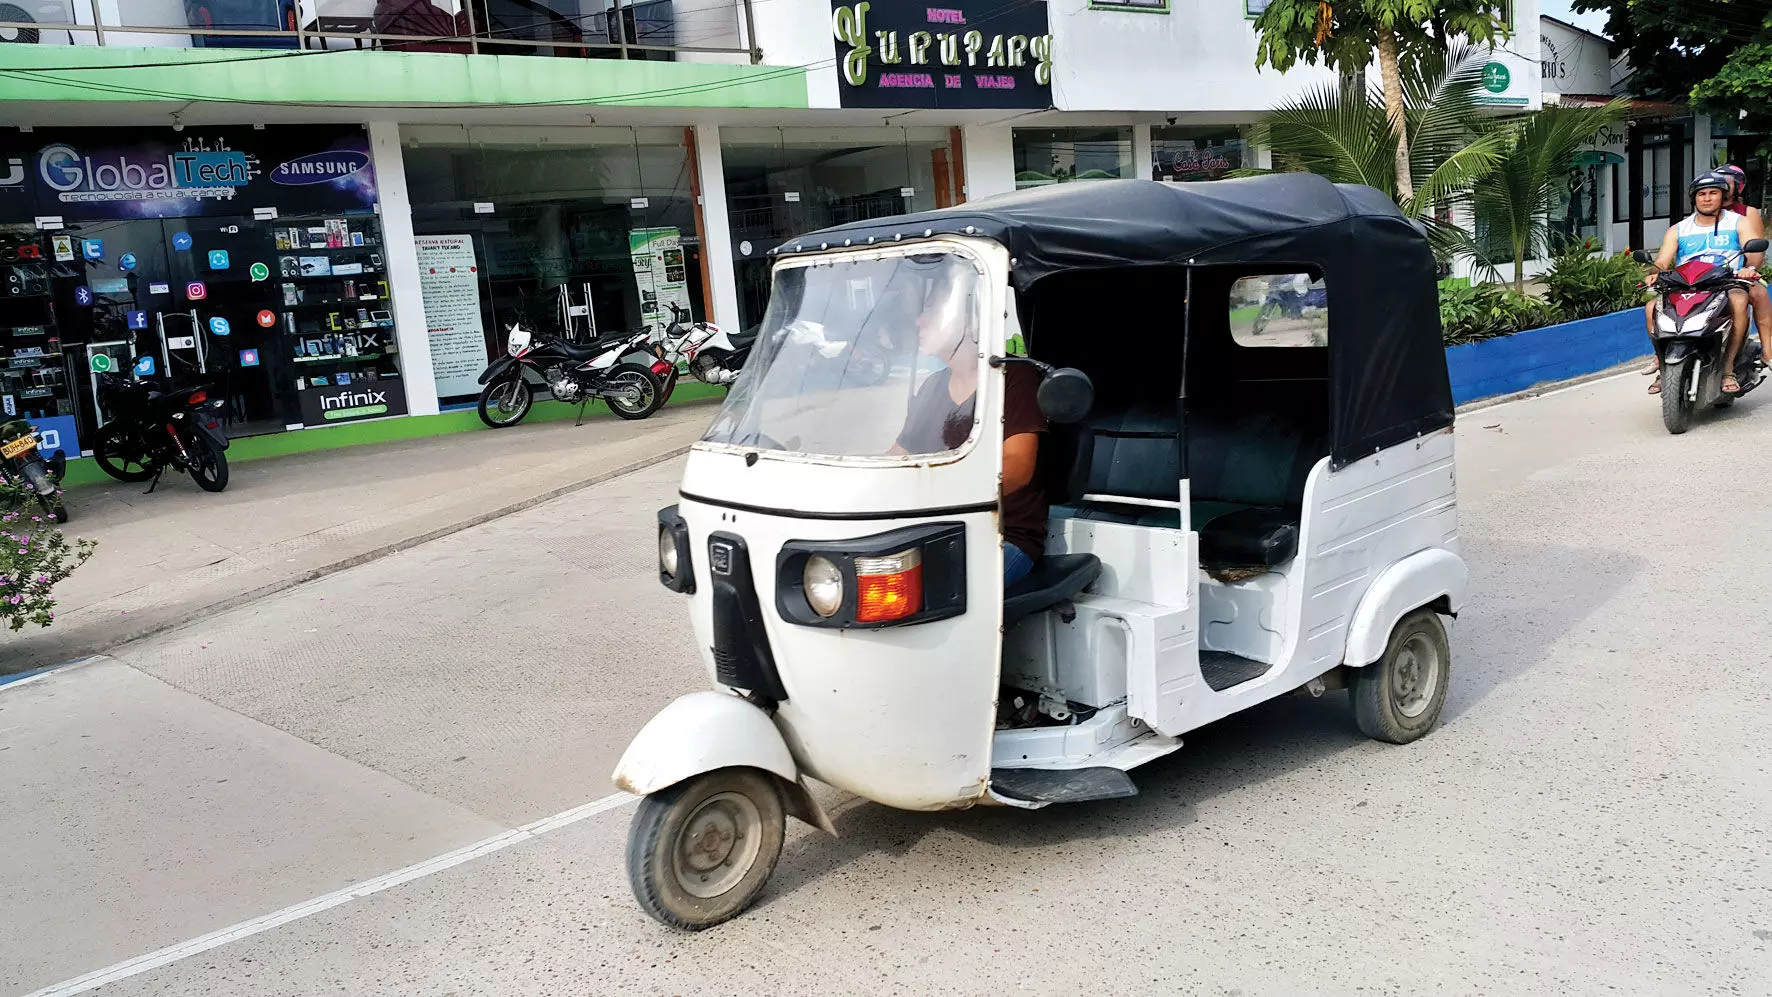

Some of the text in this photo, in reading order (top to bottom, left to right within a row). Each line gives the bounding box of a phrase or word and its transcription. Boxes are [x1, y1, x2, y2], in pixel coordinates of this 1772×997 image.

[879, 72, 1016, 89] AGENCIA DE VIAJES
[1598, 125, 1624, 147] Store
[280, 161, 357, 175] SAMSUNG
[1172, 149, 1200, 172] Casa
[652, 240, 665, 248] Full
[320, 389, 387, 410] Infinix
